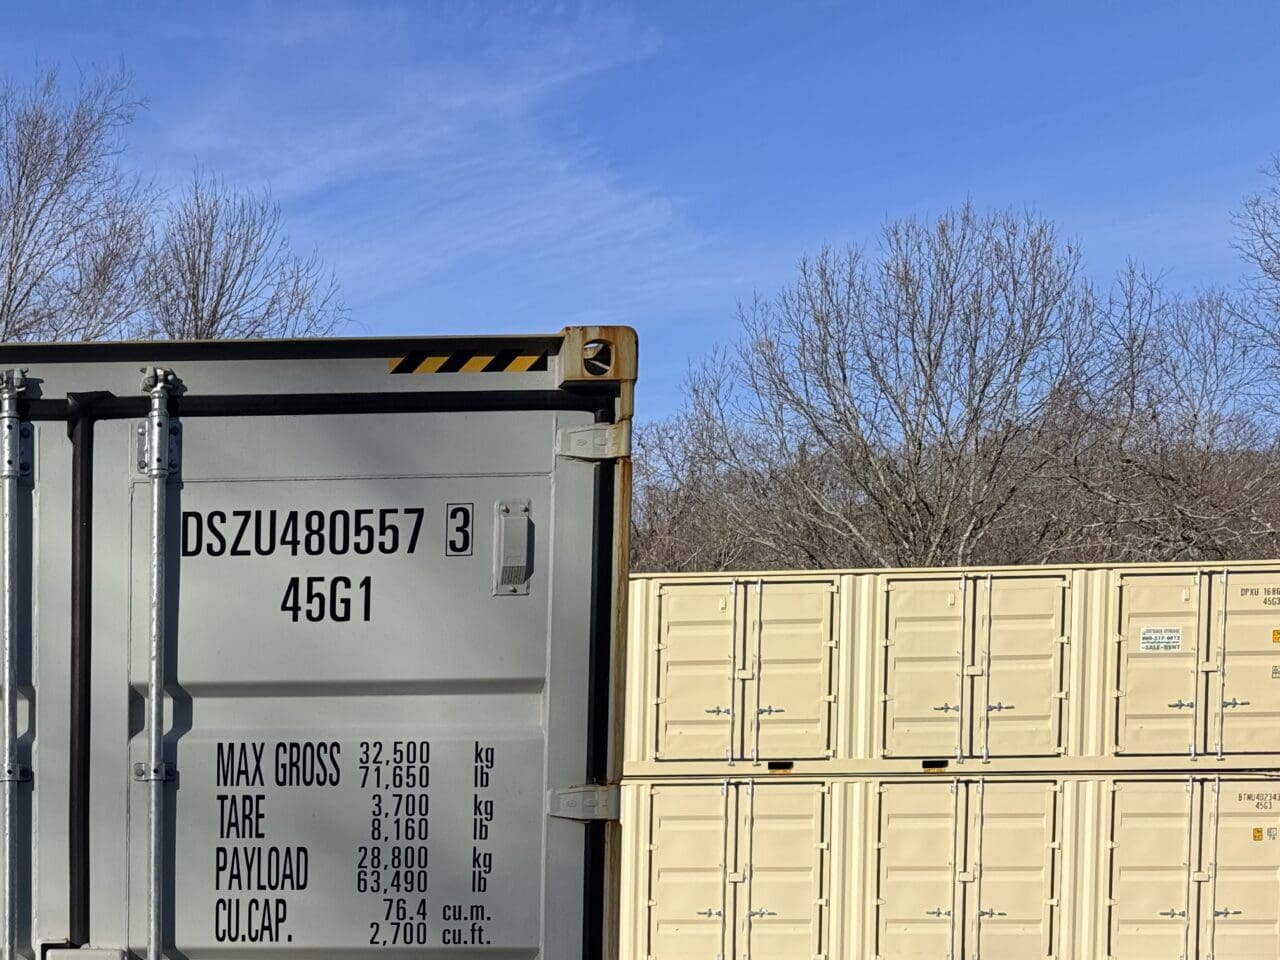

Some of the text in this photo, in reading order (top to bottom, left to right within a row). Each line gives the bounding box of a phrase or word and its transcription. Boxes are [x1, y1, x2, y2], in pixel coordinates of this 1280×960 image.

[181, 506, 471, 557] DSZU480557 3
[280, 576, 372, 622] 45G1
[216, 741, 495, 787] MAX GROSS 32,500 kg
[359, 765, 489, 790] 71,650 lb
[216, 794, 494, 839] TARE 3,700 kg
[371, 818, 488, 842] 8,160 lb
[215, 846, 492, 891] PAYLOAD 28,800 kg
[357, 870, 487, 894] 63,490 lb
[215, 898, 491, 942] CU.CAP. 76.4 cu.m.
[370, 922, 491, 946] 2,700 cu.ft.
